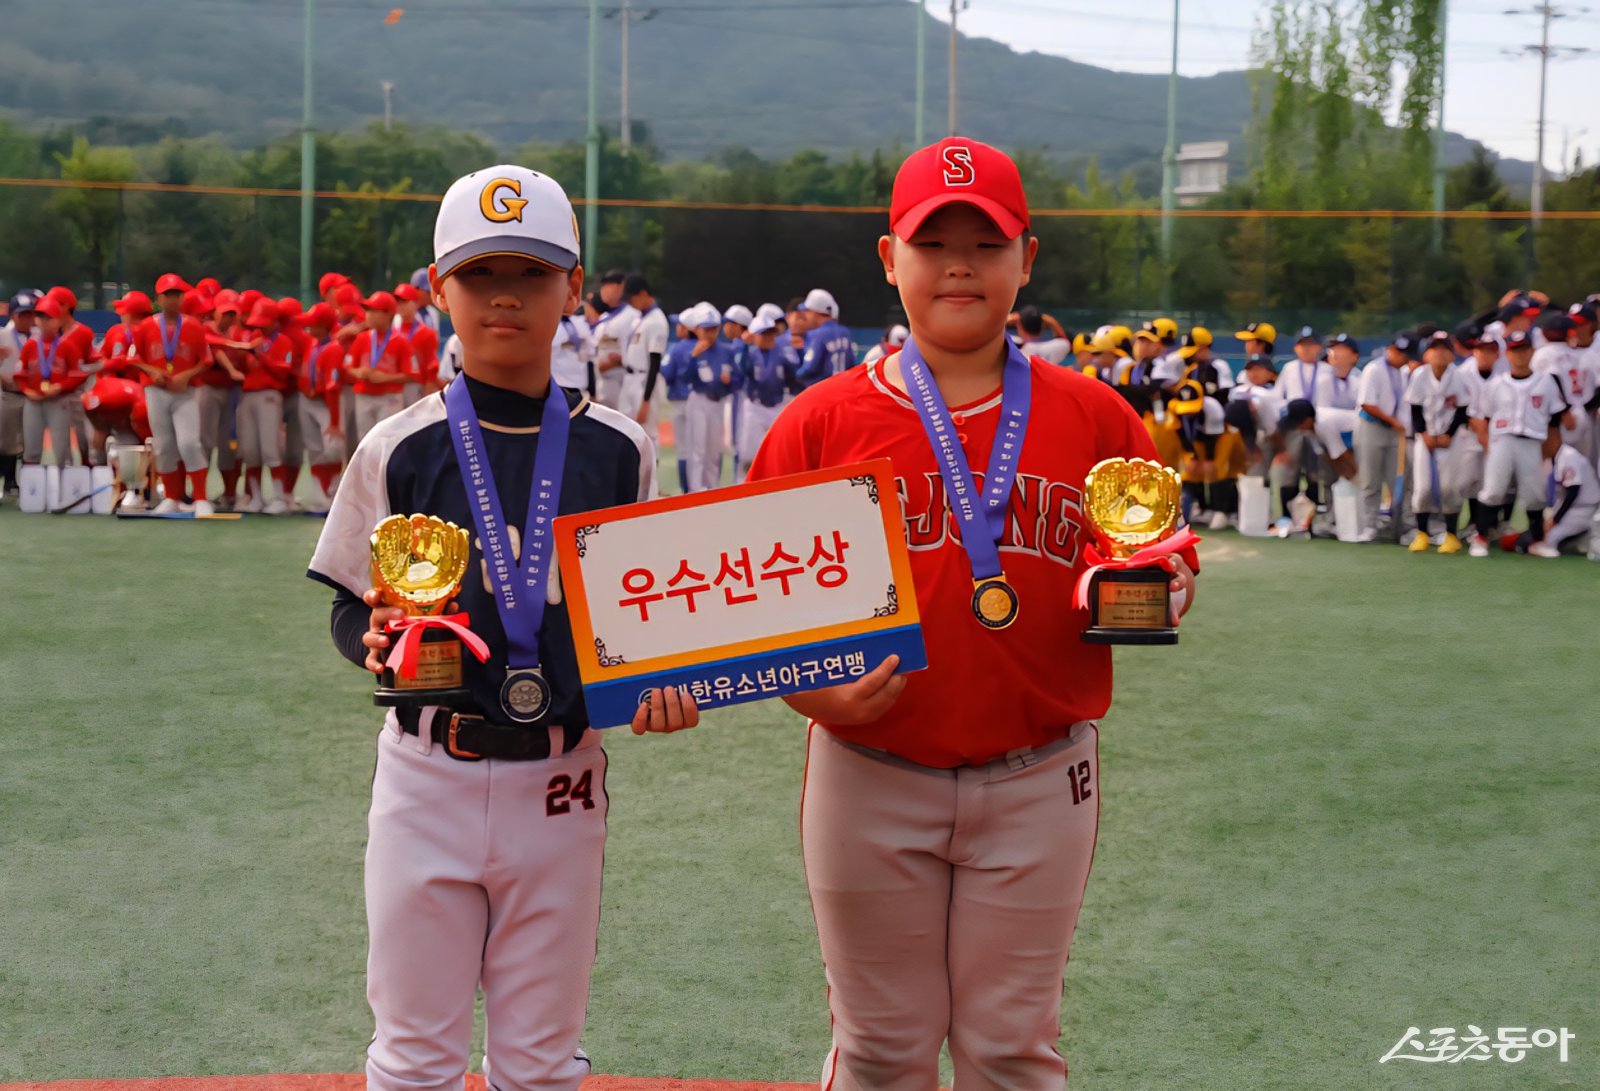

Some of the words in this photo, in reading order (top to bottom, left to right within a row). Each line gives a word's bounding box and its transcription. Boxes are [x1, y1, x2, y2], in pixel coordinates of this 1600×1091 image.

[943, 146, 975, 186] S
[480, 177, 529, 223] G
[619, 530, 849, 622] 우수선수상
[546, 769, 595, 817] 24
[1067, 760, 1092, 805] 12
